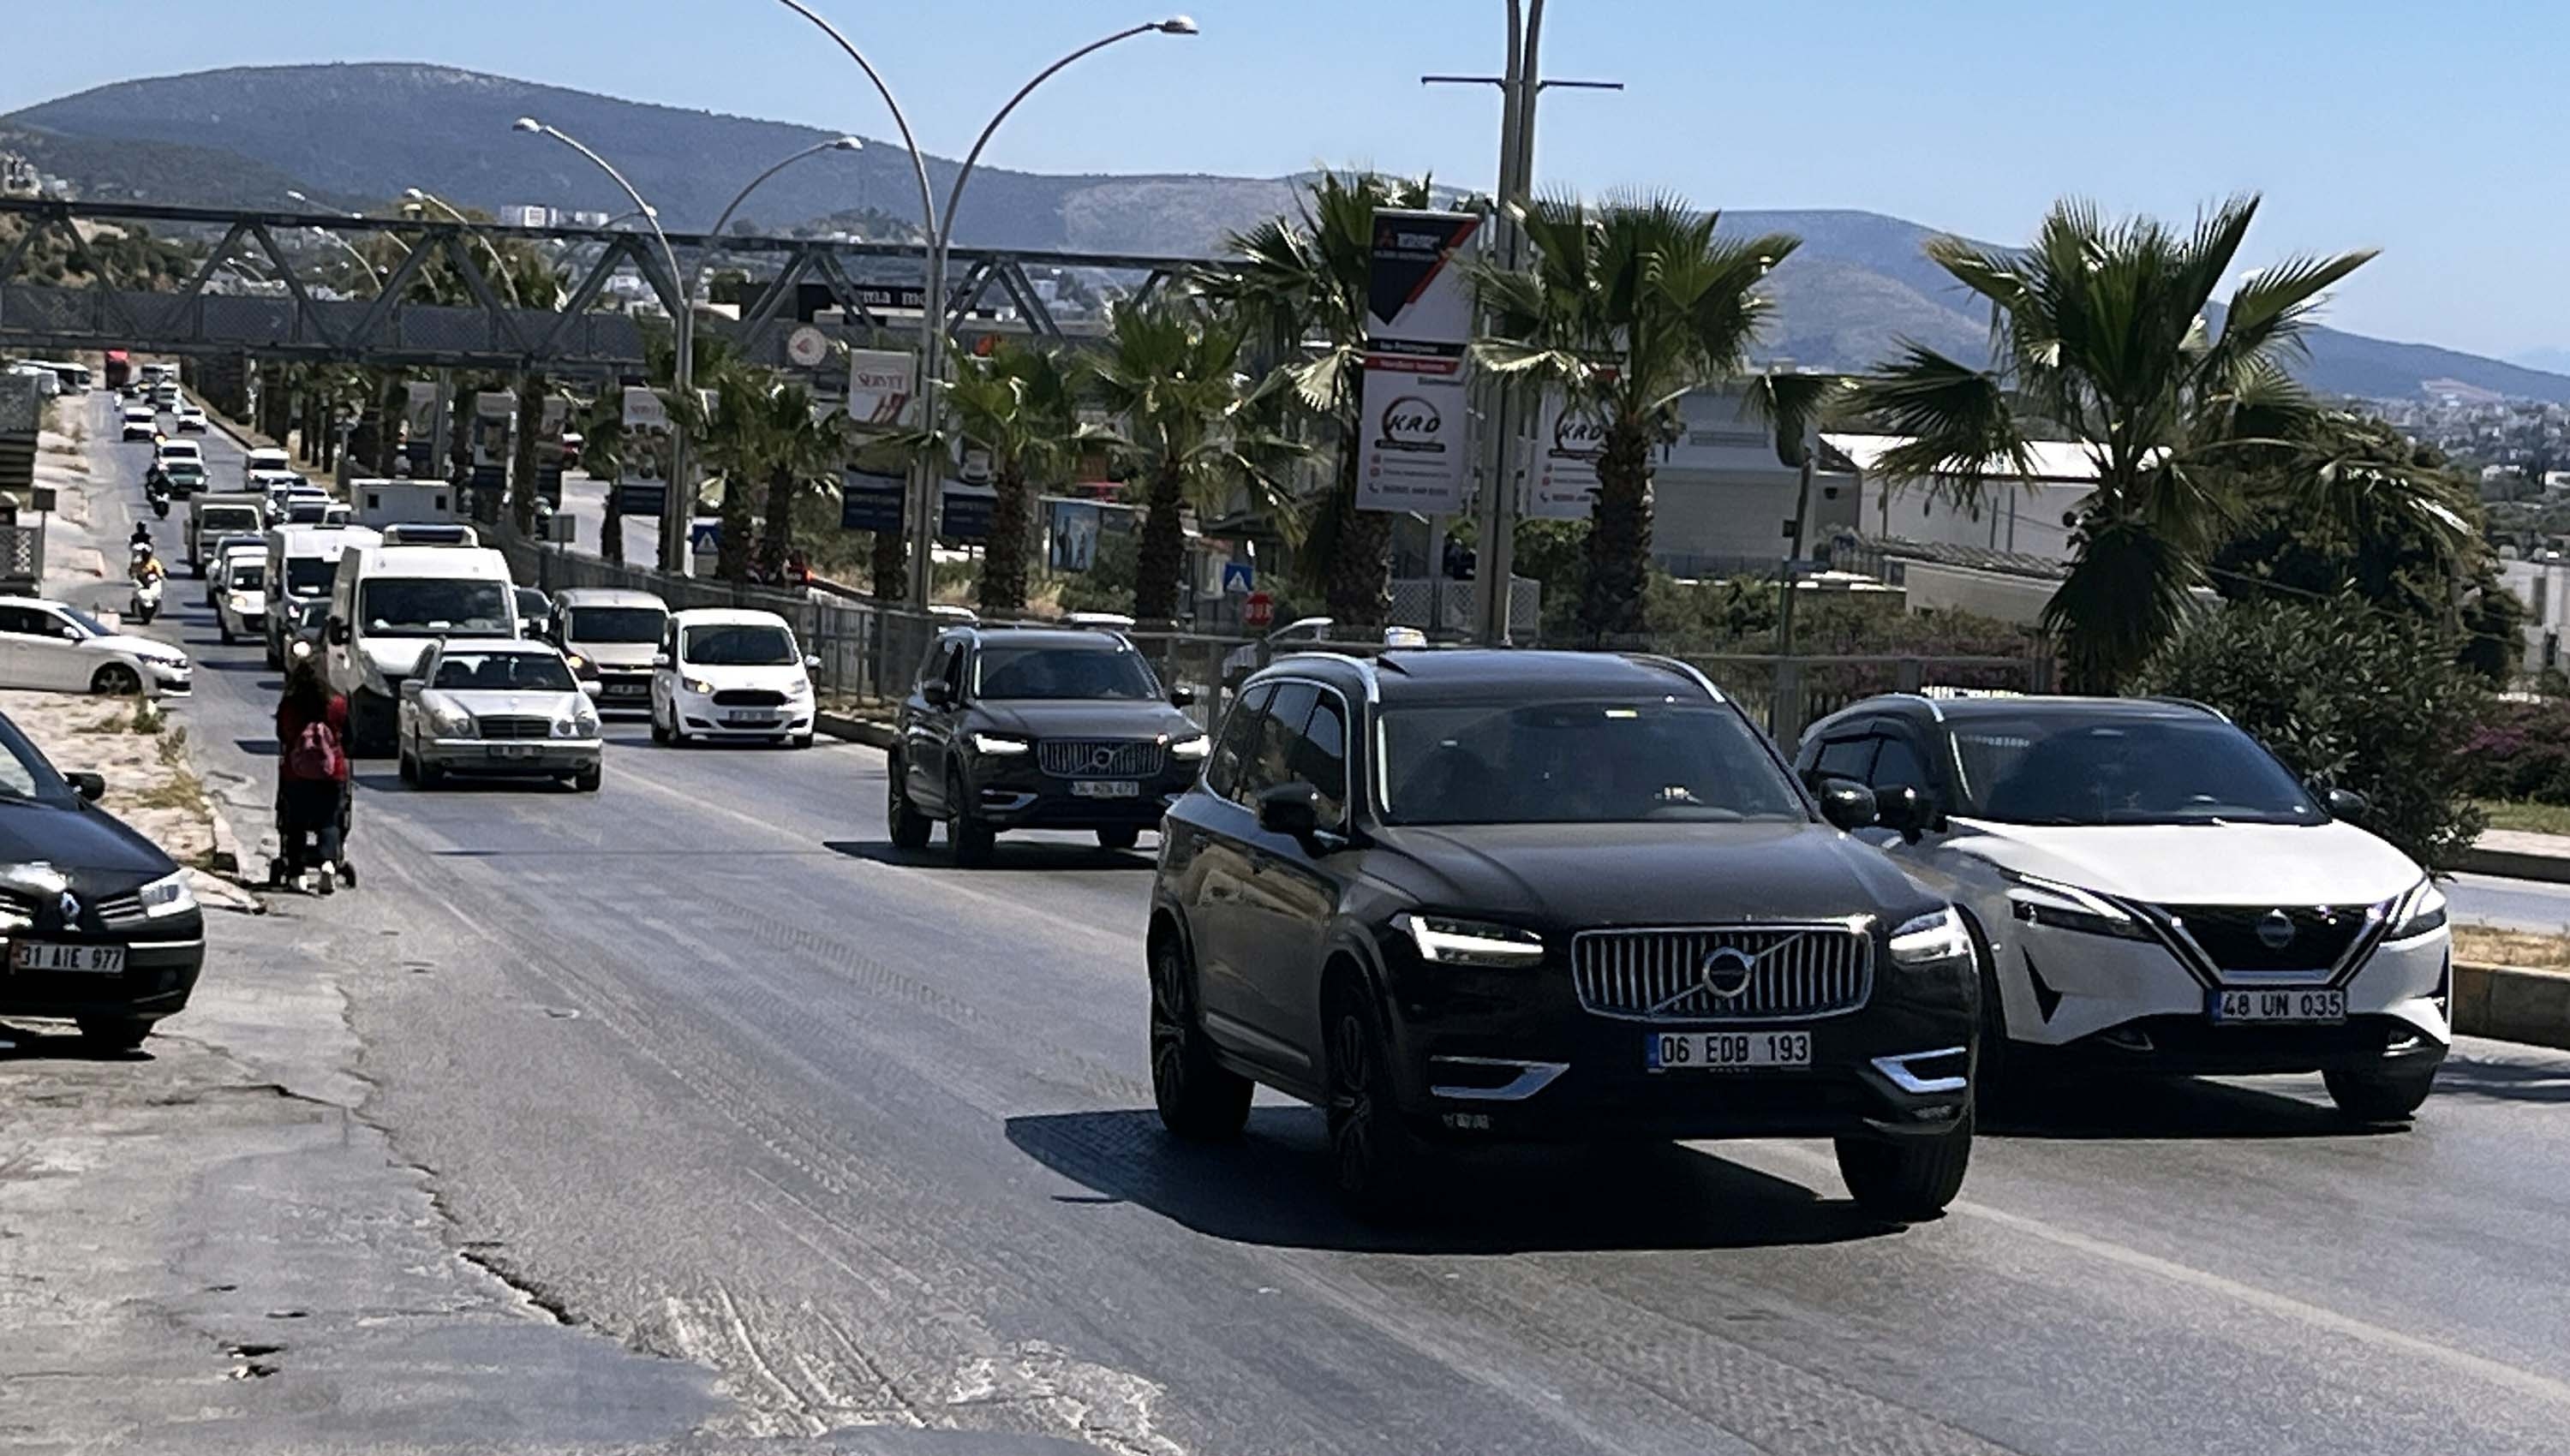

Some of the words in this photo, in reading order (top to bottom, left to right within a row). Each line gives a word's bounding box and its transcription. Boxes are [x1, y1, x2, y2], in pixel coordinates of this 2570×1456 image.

[21, 946, 42, 966] 31
[52, 946, 82, 969] AIE
[92, 947, 122, 970] 977
[2223, 993, 2250, 1017] 48
[2261, 993, 2290, 1017] UN
[2300, 994, 2341, 1017] 035
[1662, 1035, 1690, 1064] 06
[1706, 1035, 1749, 1064] EDB
[1767, 1035, 1808, 1062] 193
